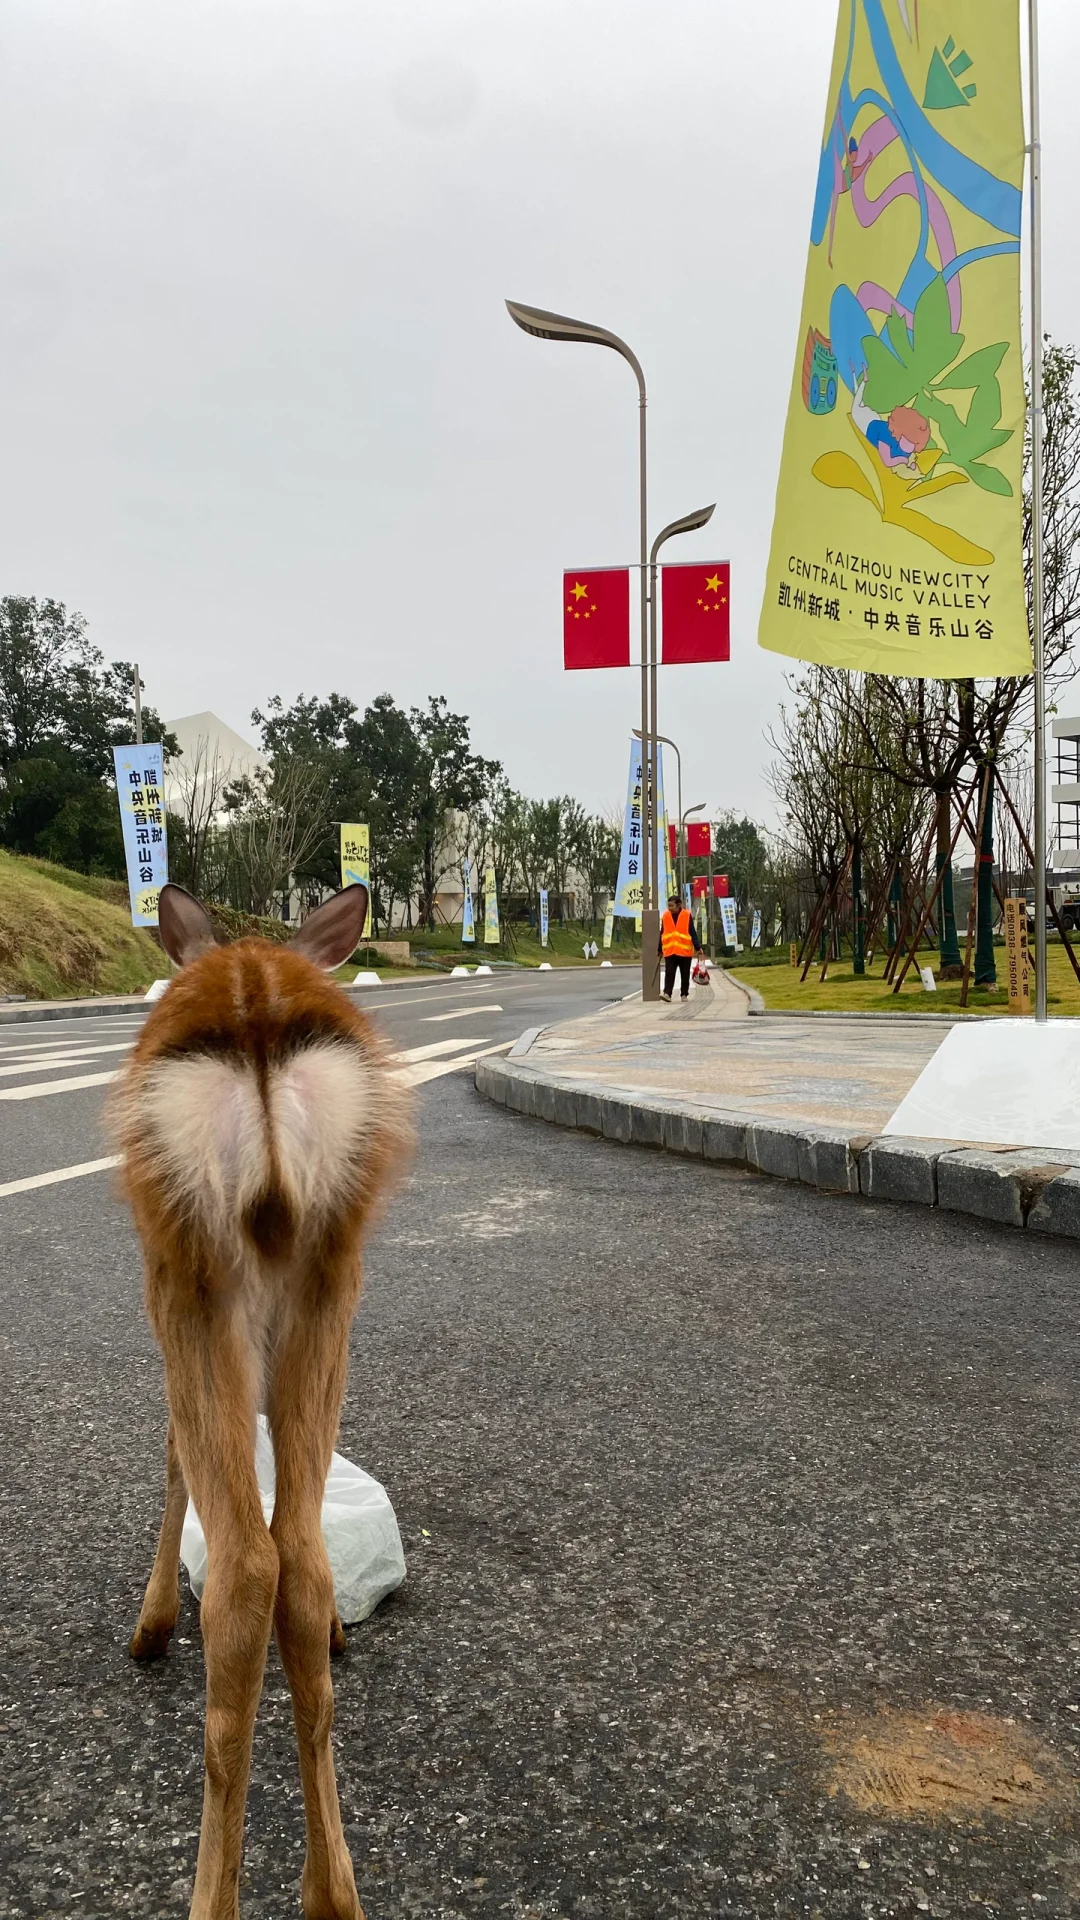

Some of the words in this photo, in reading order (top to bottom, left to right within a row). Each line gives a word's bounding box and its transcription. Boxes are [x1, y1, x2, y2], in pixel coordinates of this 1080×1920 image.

[788, 555, 848, 591] CENTRAL
[855, 578, 904, 602] MUSIC
[912, 590, 991, 610] VALLEY
[825, 547, 892, 580] KAIZHOU
[900, 567, 990, 590] NEWCITY
